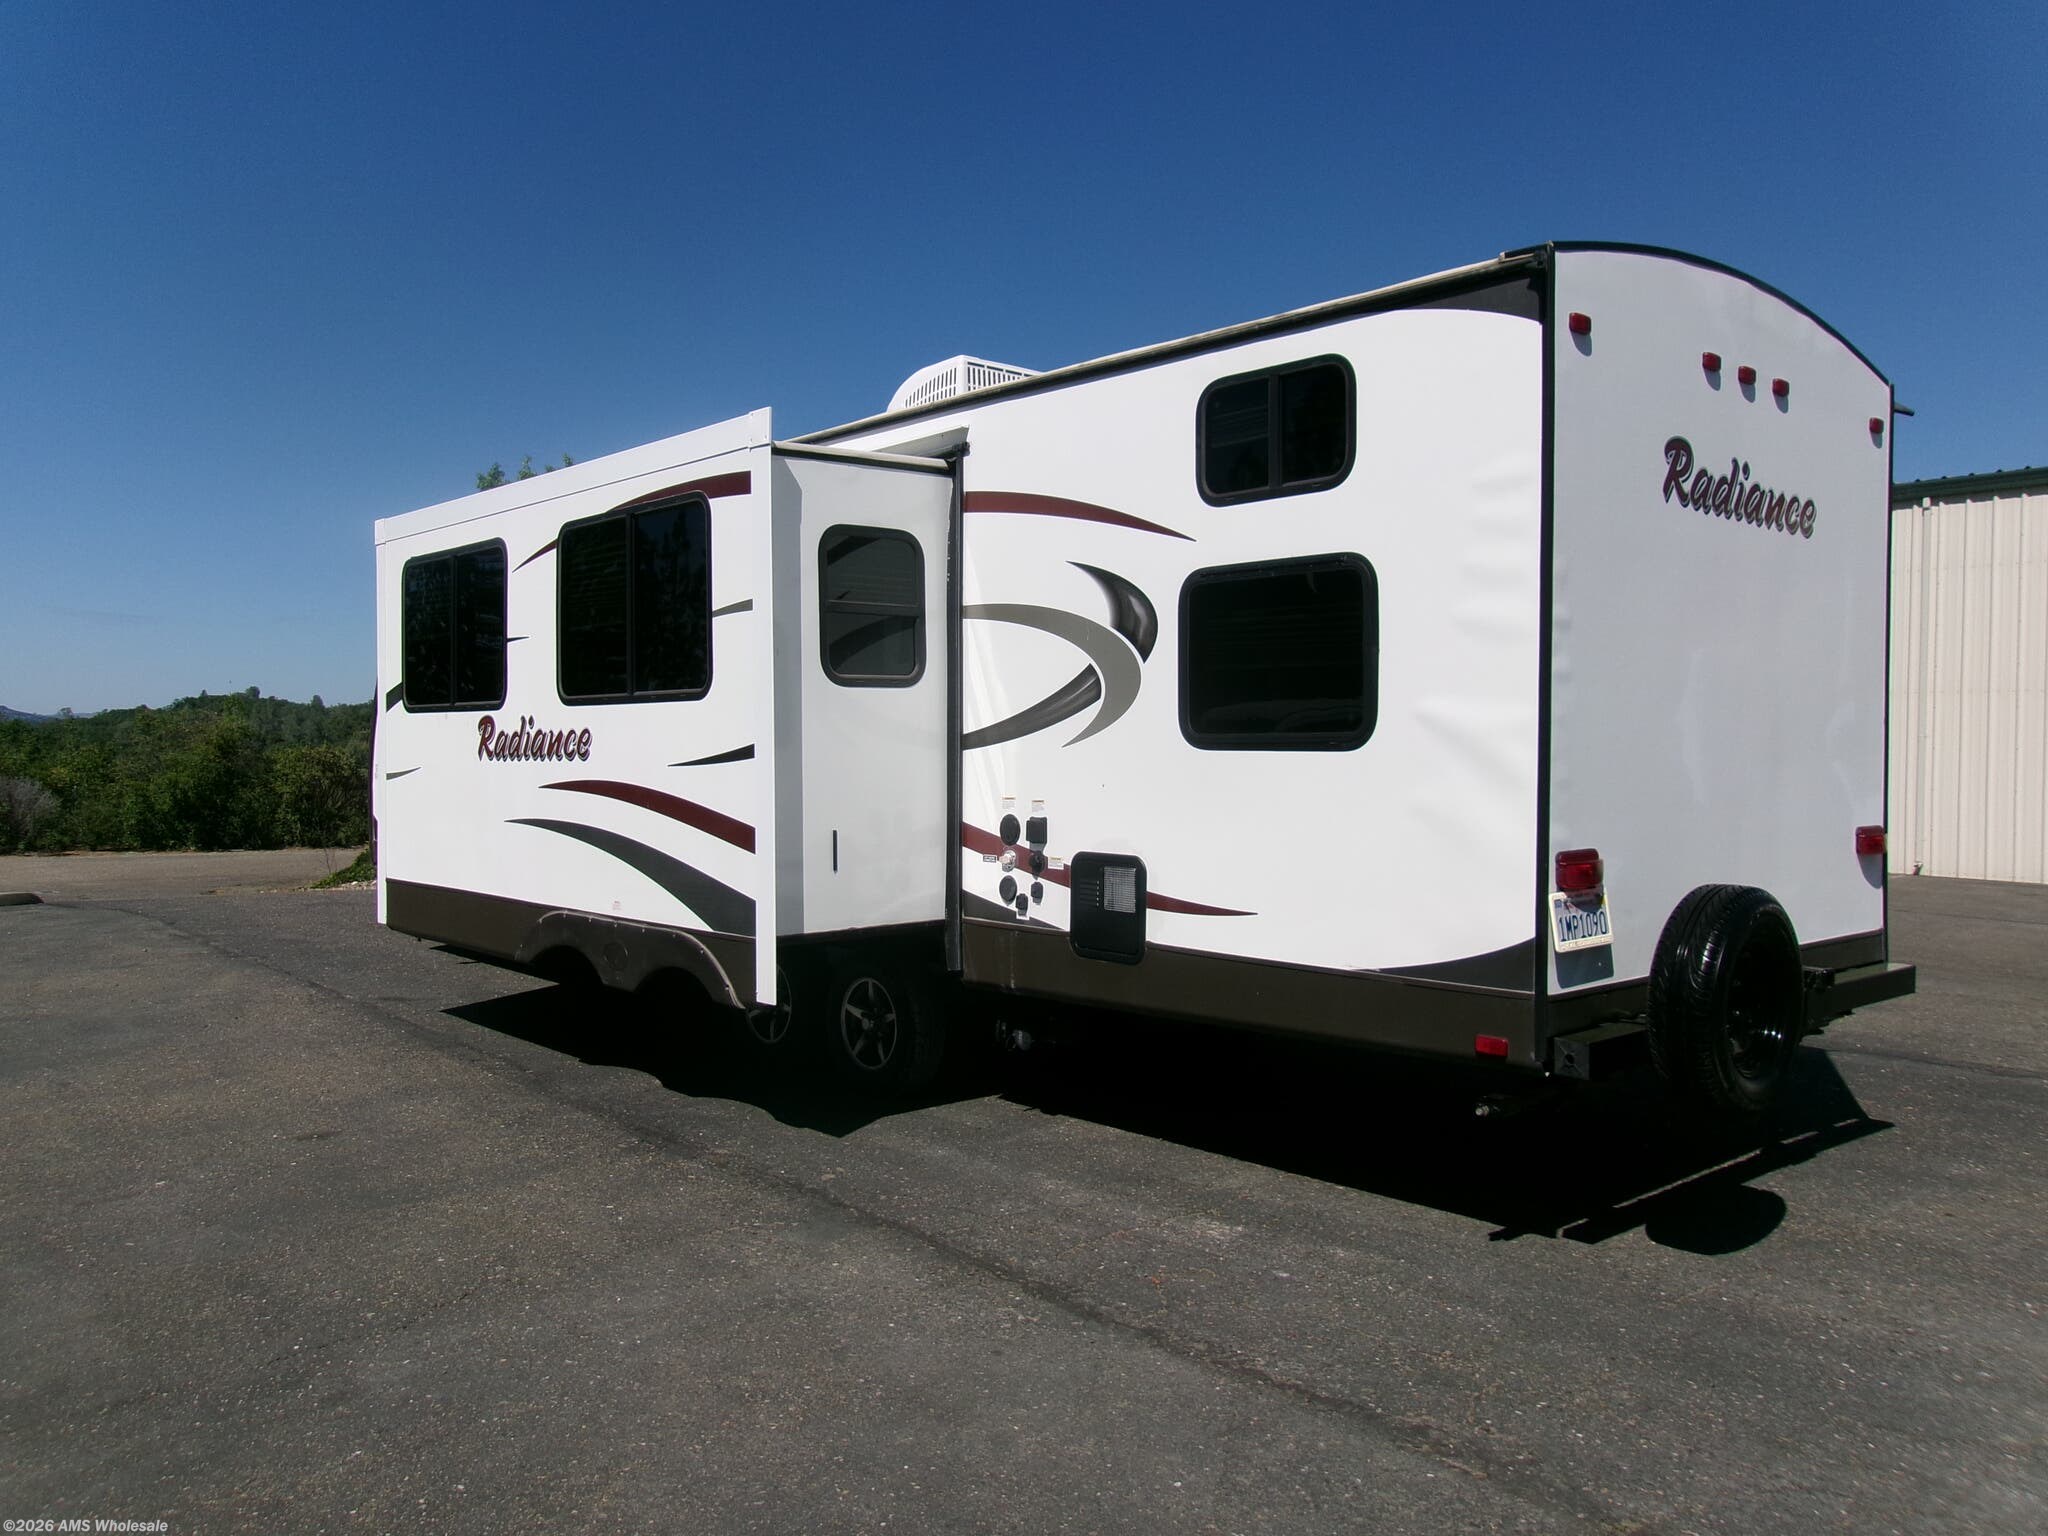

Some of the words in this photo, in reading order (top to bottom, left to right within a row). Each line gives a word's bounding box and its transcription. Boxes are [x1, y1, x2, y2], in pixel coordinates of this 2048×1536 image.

[1663, 435, 1817, 539] Radiance
[478, 715, 592, 762] Radiance
[1558, 911, 1607, 942] 1MP1090
